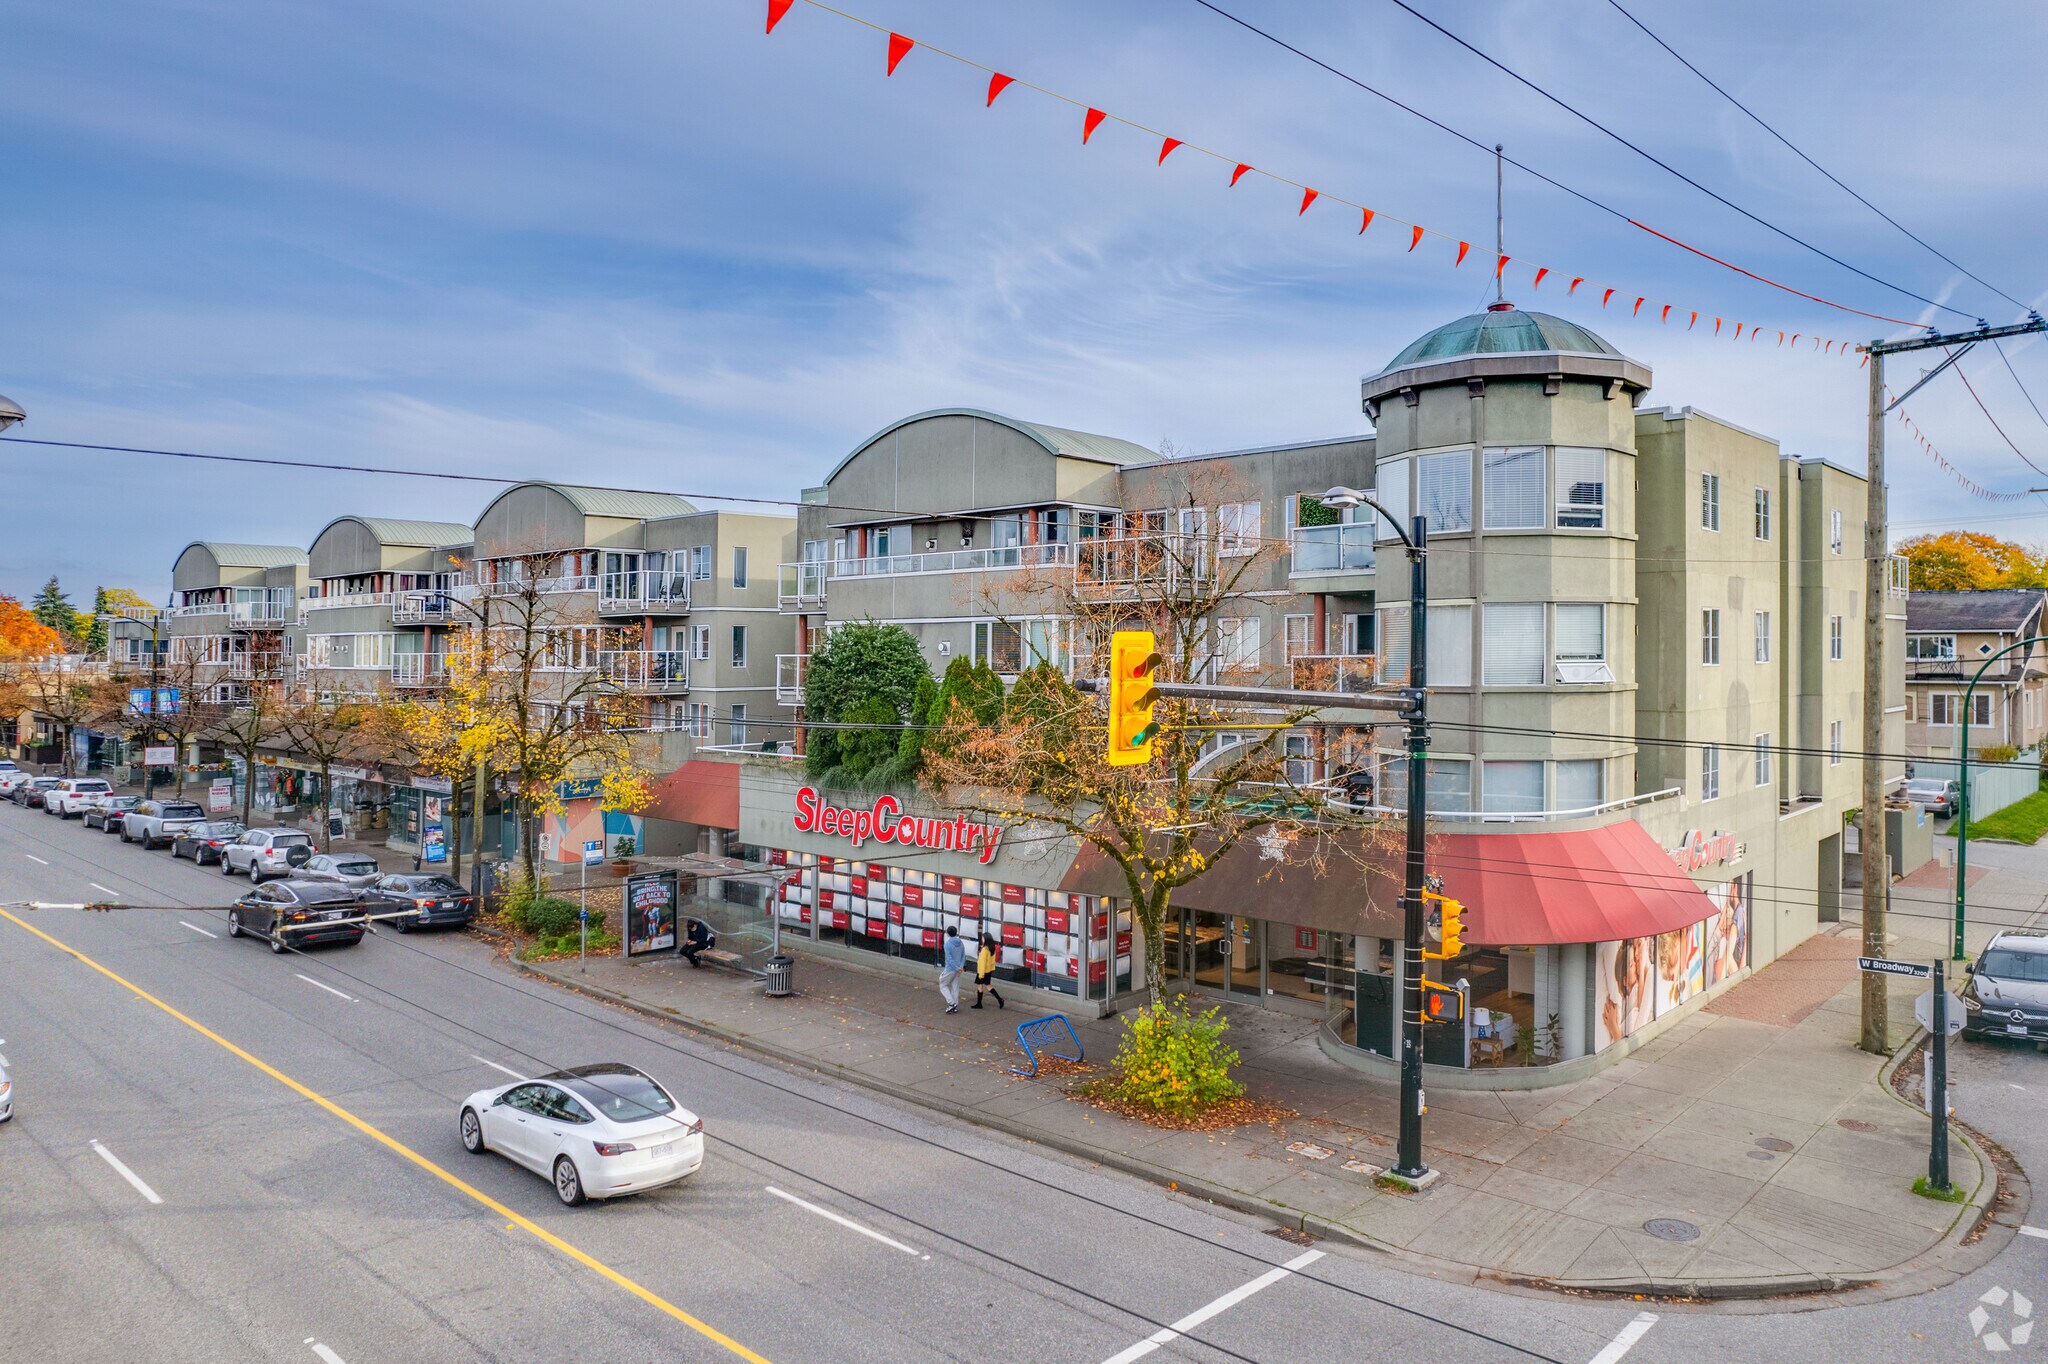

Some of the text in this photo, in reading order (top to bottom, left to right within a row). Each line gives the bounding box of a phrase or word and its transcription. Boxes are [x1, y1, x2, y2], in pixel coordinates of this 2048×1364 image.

[636, 886, 655, 895] BRING
[633, 894, 645, 902] JOY
[646, 891, 661, 899] BACK
[635, 898, 668, 907] CHILDHOOD
[1861, 959, 1871, 968] W
[1873, 962, 1914, 974] Broadway
